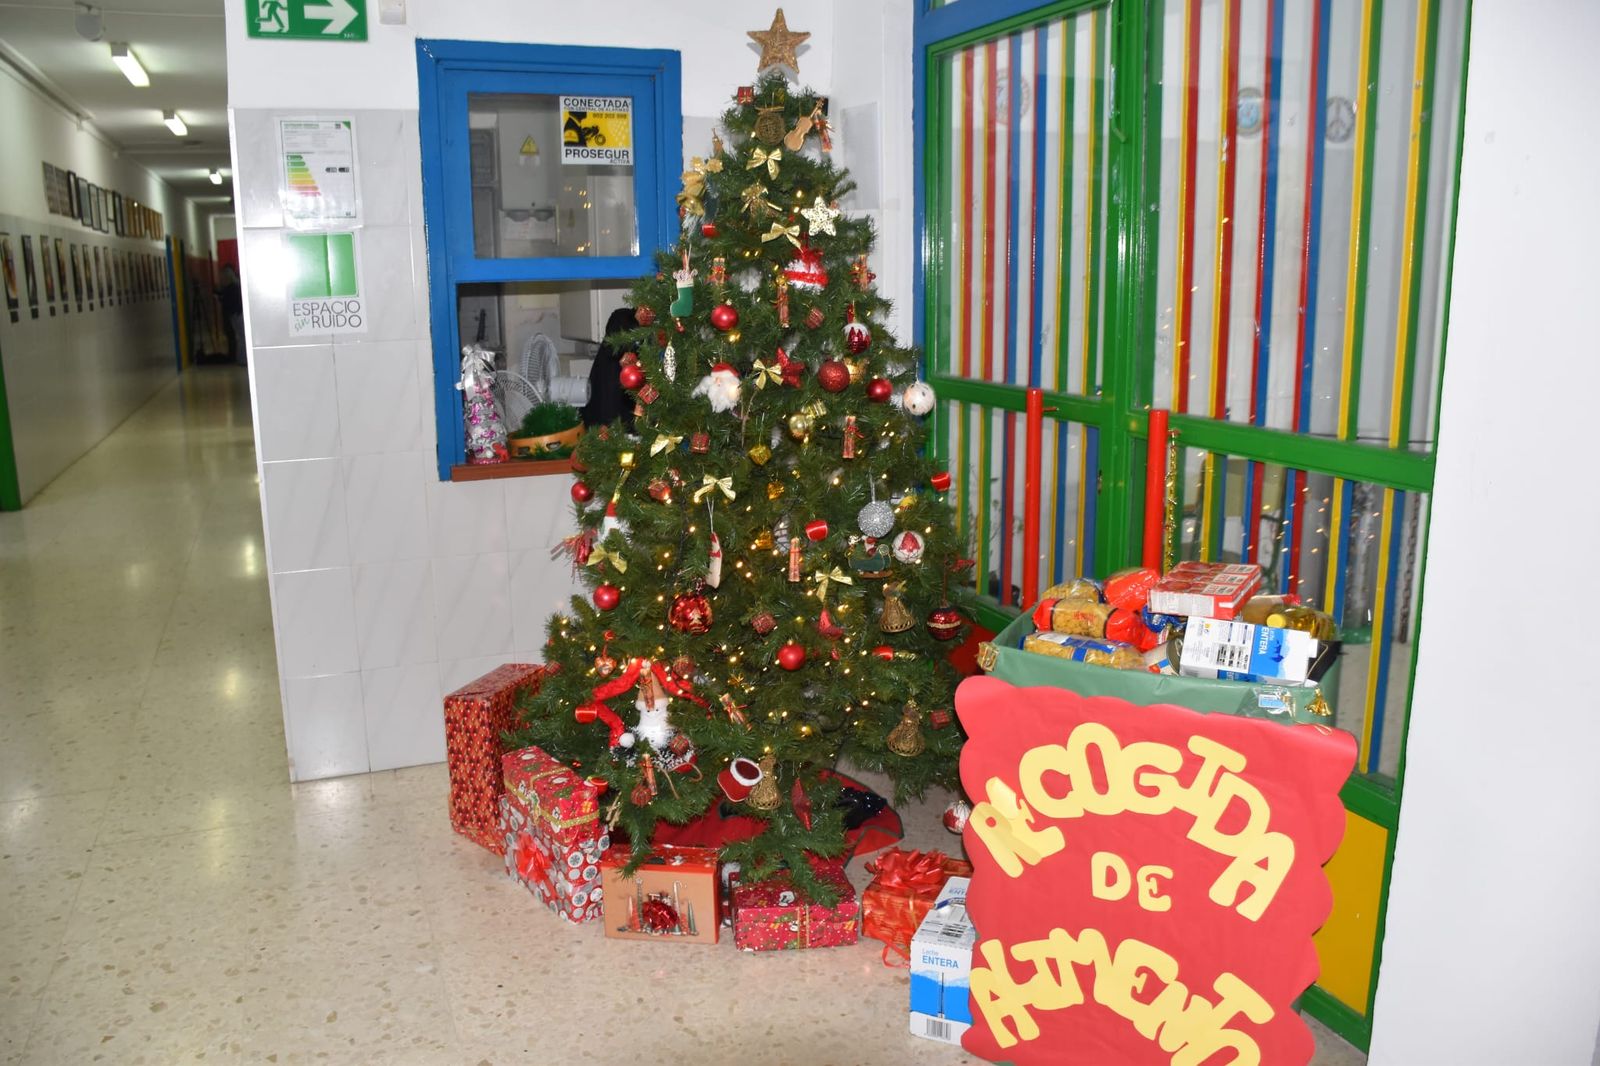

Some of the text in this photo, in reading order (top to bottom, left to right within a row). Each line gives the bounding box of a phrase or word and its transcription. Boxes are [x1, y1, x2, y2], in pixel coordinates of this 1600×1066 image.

[564, 98, 629, 108] CONECTADA
[565, 149, 629, 159] PROSEGUR
[293, 300, 361, 316] ESPACIO
[294, 314, 362, 332] sin RUIDO
[1258, 626, 1270, 655] ENTERA
[969, 722, 1295, 922] RECOGIDA
[1091, 851, 1173, 912] DE
[922, 955, 959, 968] ENTERA
